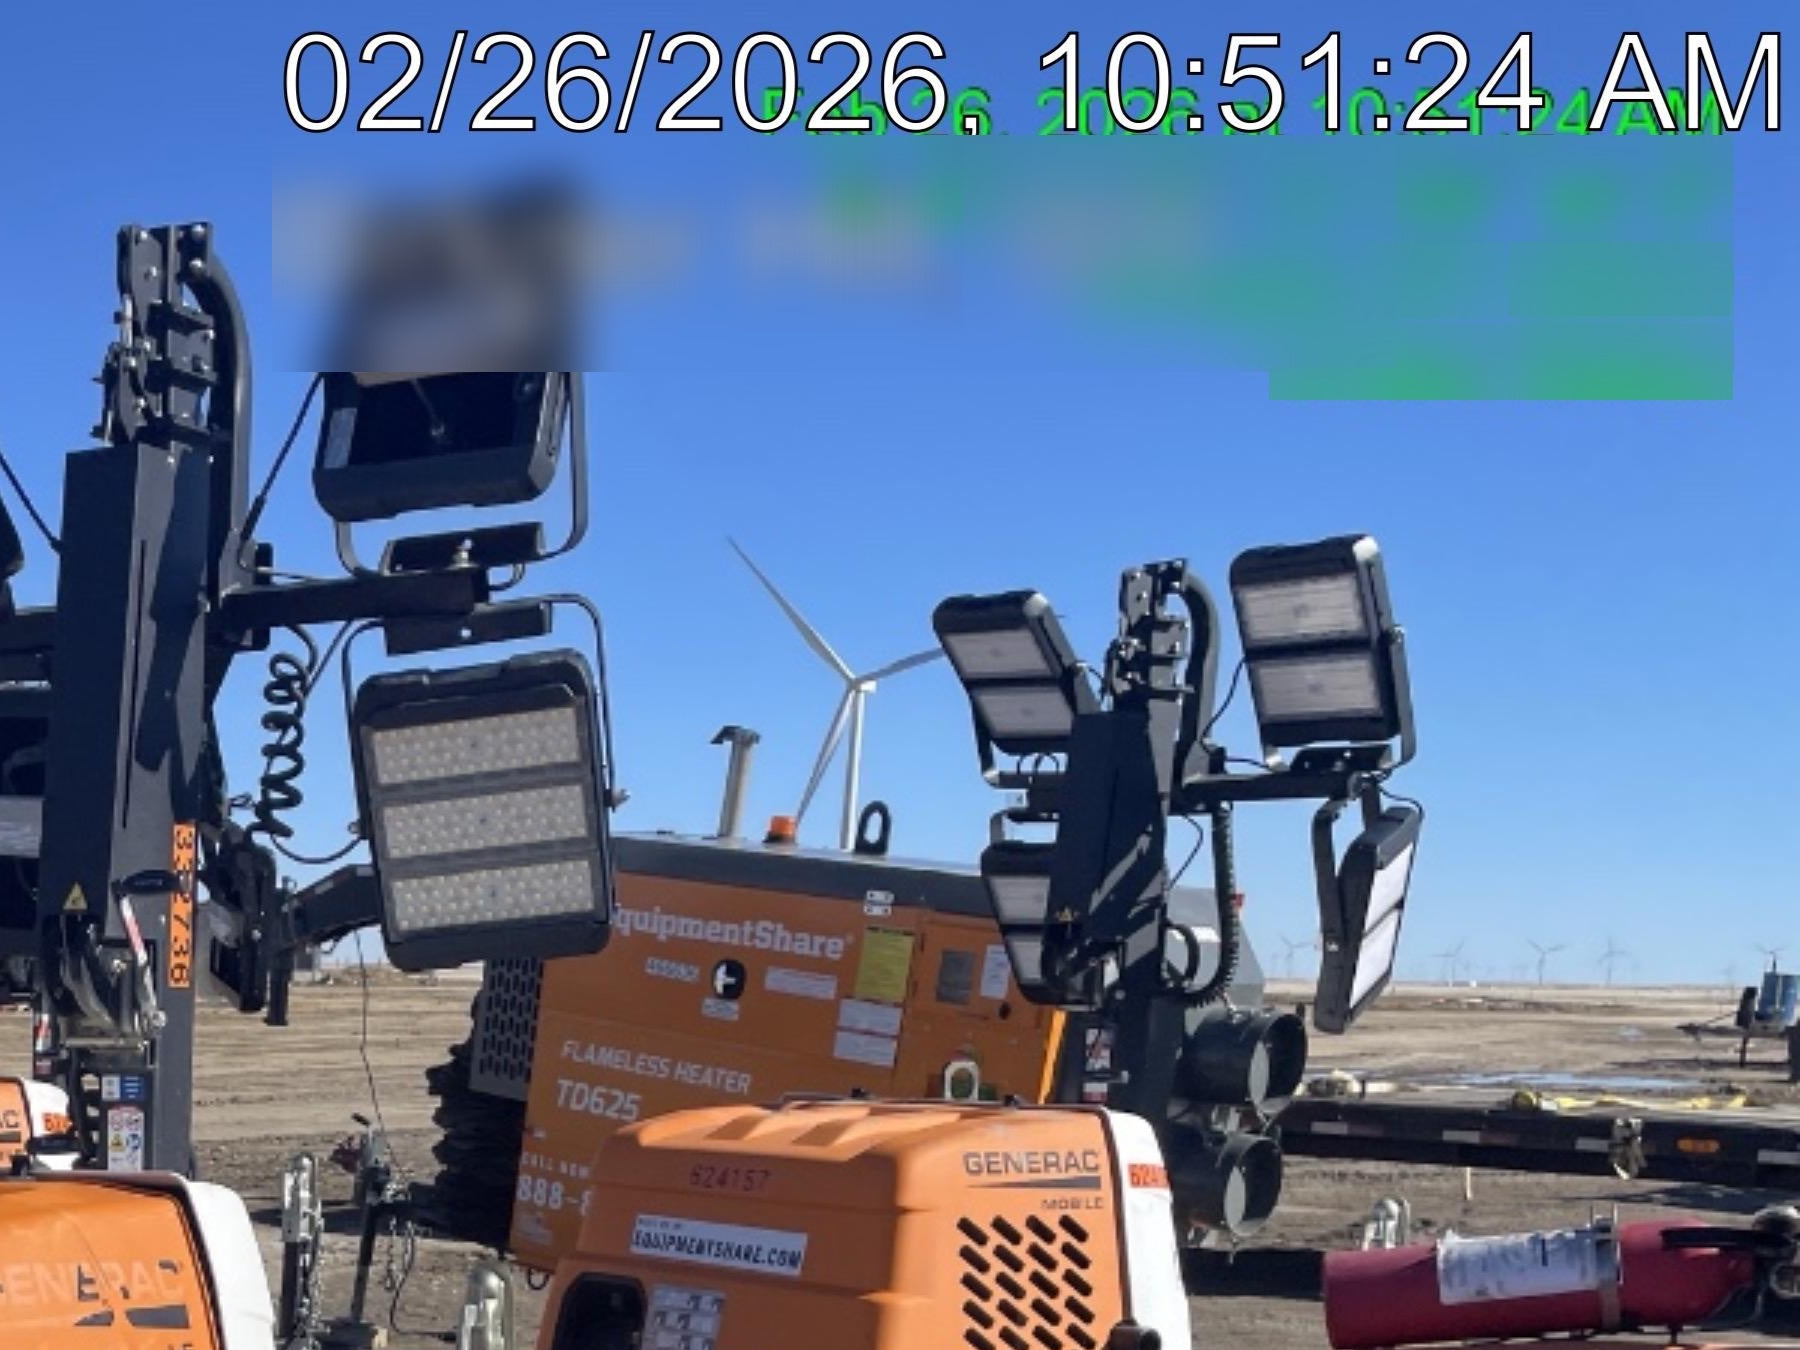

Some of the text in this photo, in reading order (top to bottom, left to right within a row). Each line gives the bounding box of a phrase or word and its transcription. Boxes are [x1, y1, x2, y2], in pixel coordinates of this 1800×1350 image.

[611, 903, 845, 961] quipmentShare
[561, 1040, 752, 1096] FLAMELESS HEATER
[963, 1150, 1099, 1176] GENERAC
[634, 1229, 801, 1268] EQUIPMENTSHARE.COM
